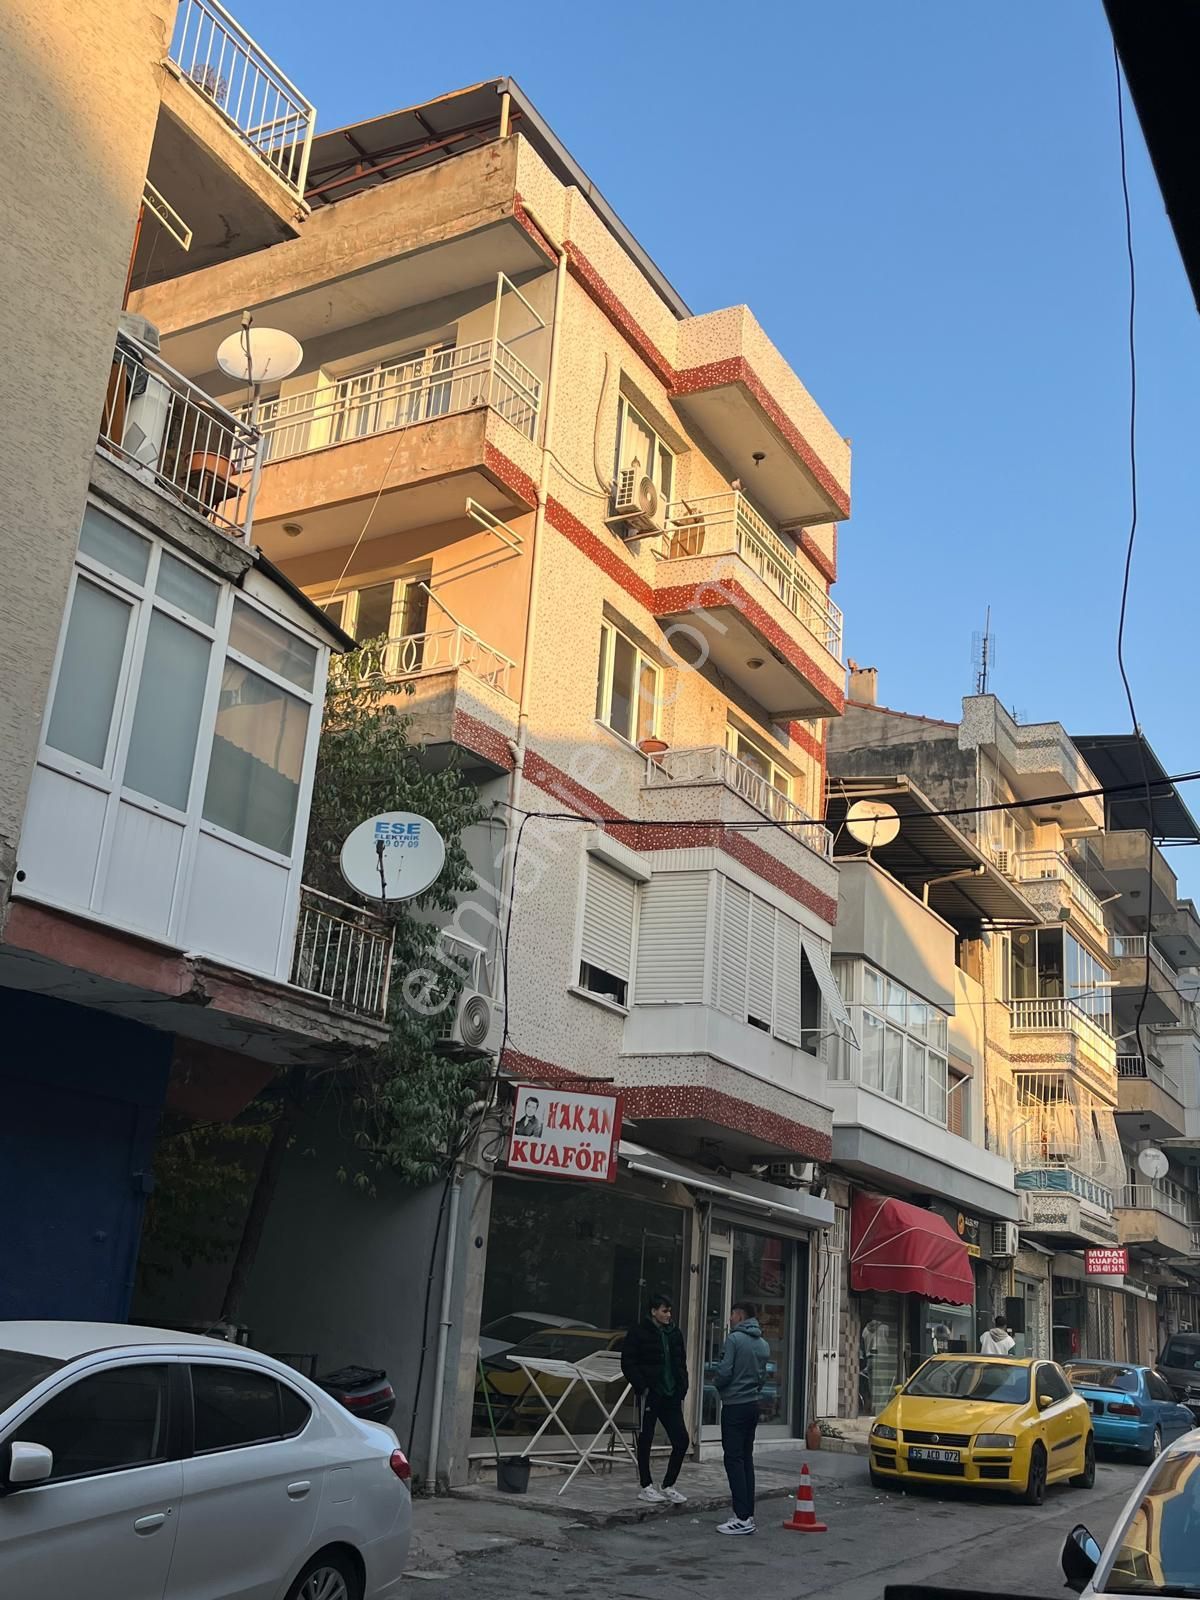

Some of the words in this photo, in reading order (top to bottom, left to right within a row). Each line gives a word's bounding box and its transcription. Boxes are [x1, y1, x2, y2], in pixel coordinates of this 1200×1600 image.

[375, 822, 421, 834] ESE
[393, 840, 405, 848] 07
[407, 840, 419, 848] 09
[511, 1140, 607, 1173] KUAFÖR
[913, 1449, 923, 1458] 35
[944, 1451, 958, 1462] 072
